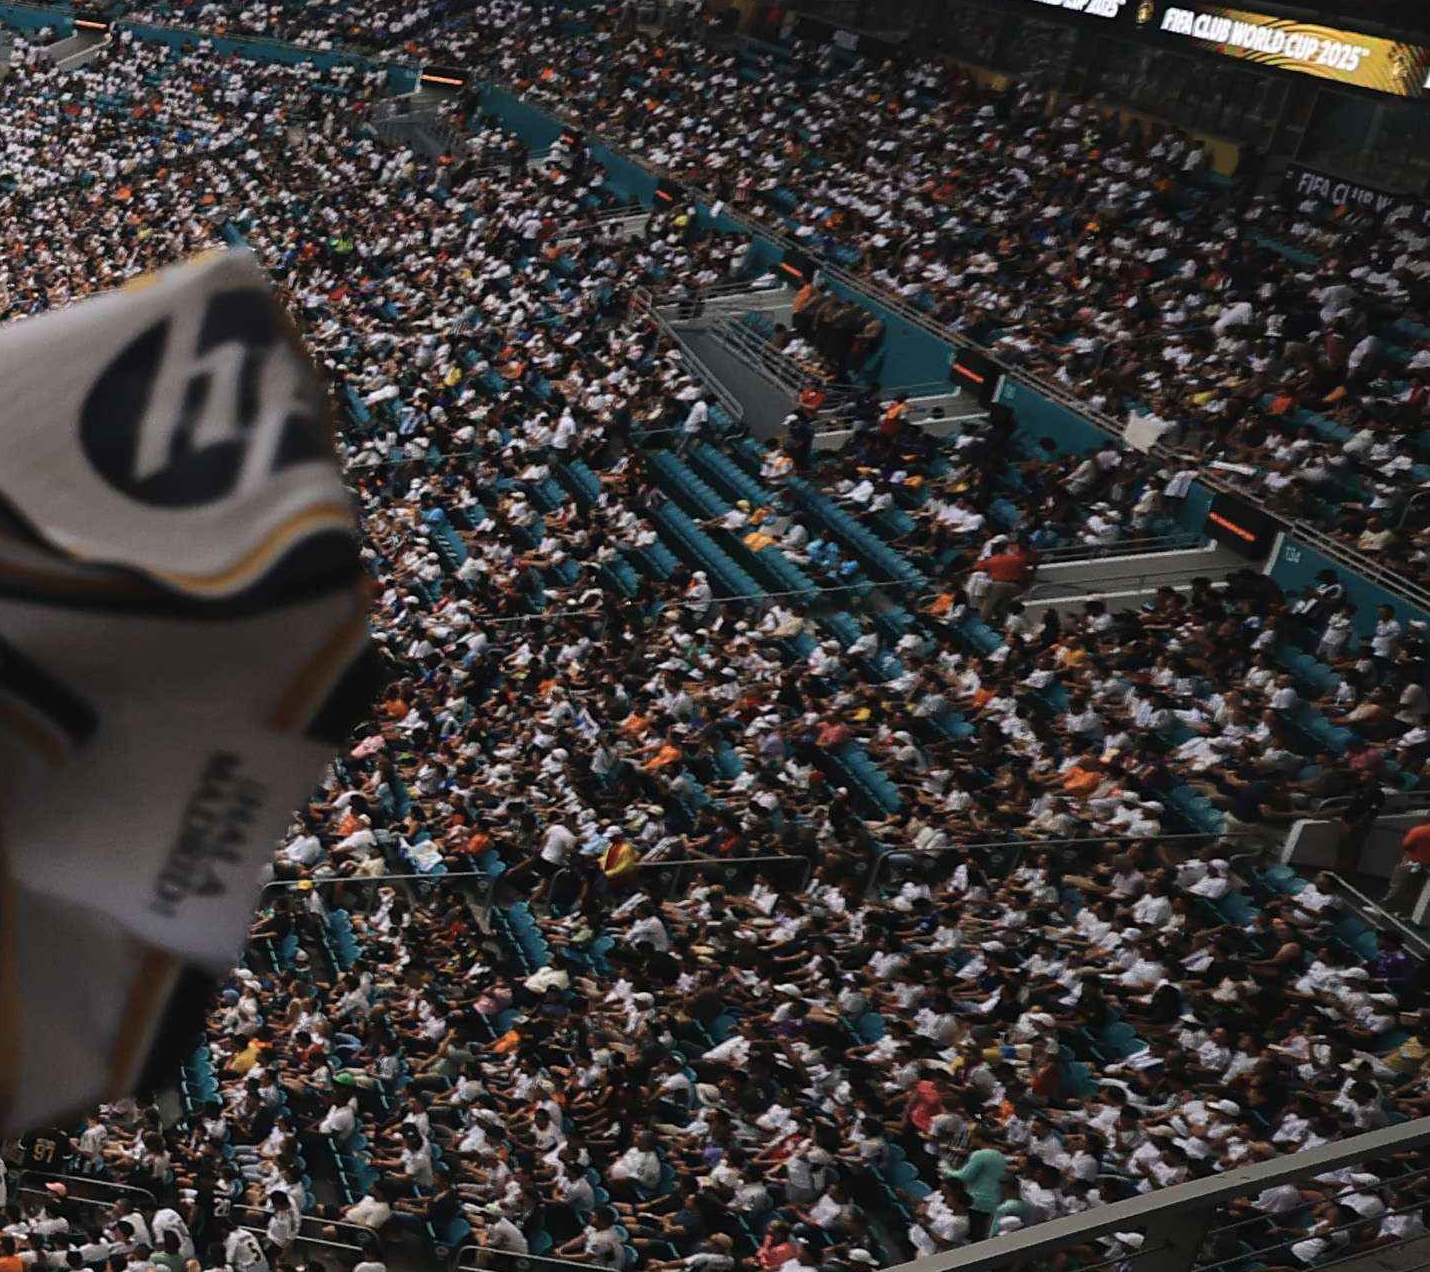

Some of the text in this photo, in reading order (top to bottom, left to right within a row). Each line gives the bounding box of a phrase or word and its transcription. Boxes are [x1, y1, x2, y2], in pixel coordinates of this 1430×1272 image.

[1161, 7, 1194, 35] FIFA
[1193, 14, 1232, 43] CLUB
[1228, 21, 1285, 53] WORLD
[1284, 32, 1318, 61] CUP
